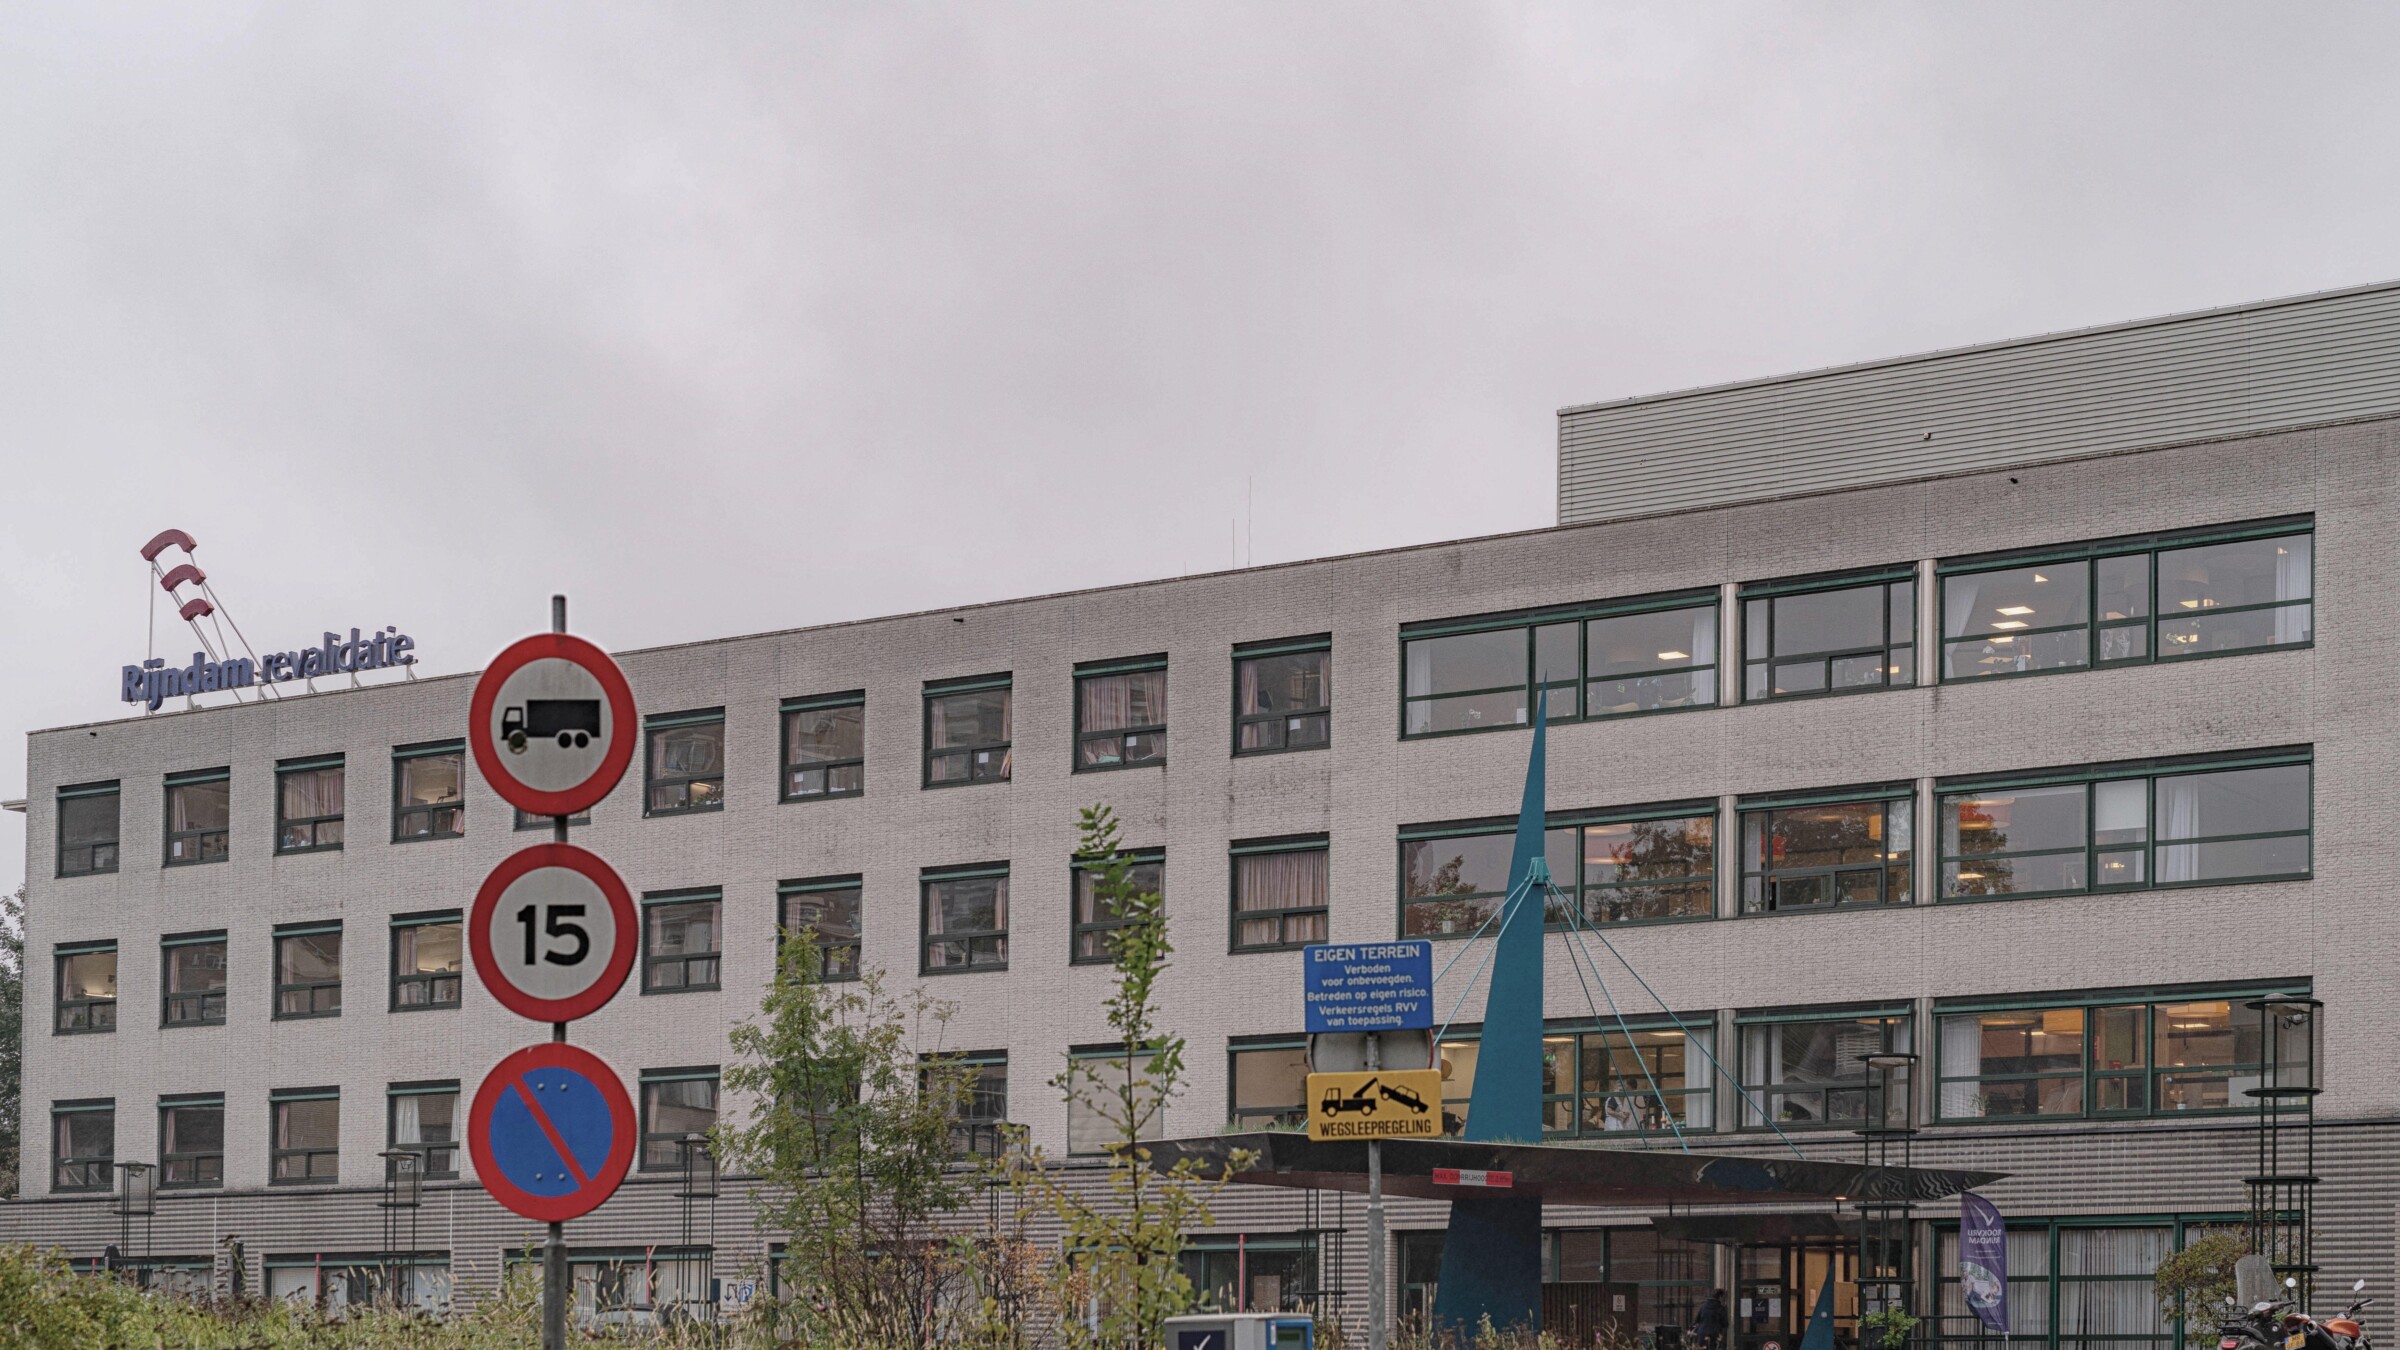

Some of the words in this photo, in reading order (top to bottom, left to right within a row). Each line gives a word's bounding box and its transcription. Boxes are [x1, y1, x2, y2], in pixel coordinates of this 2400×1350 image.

[121, 651, 254, 711] Rijndam
[261, 625, 415, 684] revalidatie
[516, 904, 590, 966] 15
[1314, 949, 1356, 962] EIGEN
[1360, 945, 1420, 960] TERREIN
[1344, 964, 1391, 975] Verboden
[1321, 978, 1343, 987] voor
[1347, 974, 1414, 988] onbevoegden.
[1307, 991, 1352, 1002] Betreden
[1355, 992, 1367, 1003] op
[1370, 989, 1396, 1001] eigen
[1399, 988, 1429, 998] risico.
[1319, 1004, 1392, 1016] Verkeersregels
[1395, 1002, 1418, 1012] RVV
[1326, 1017, 1344, 1027] van
[1348, 1015, 1404, 1027] toepassing.
[1320, 1119, 1432, 1137] WEGSLEEPREGELING
